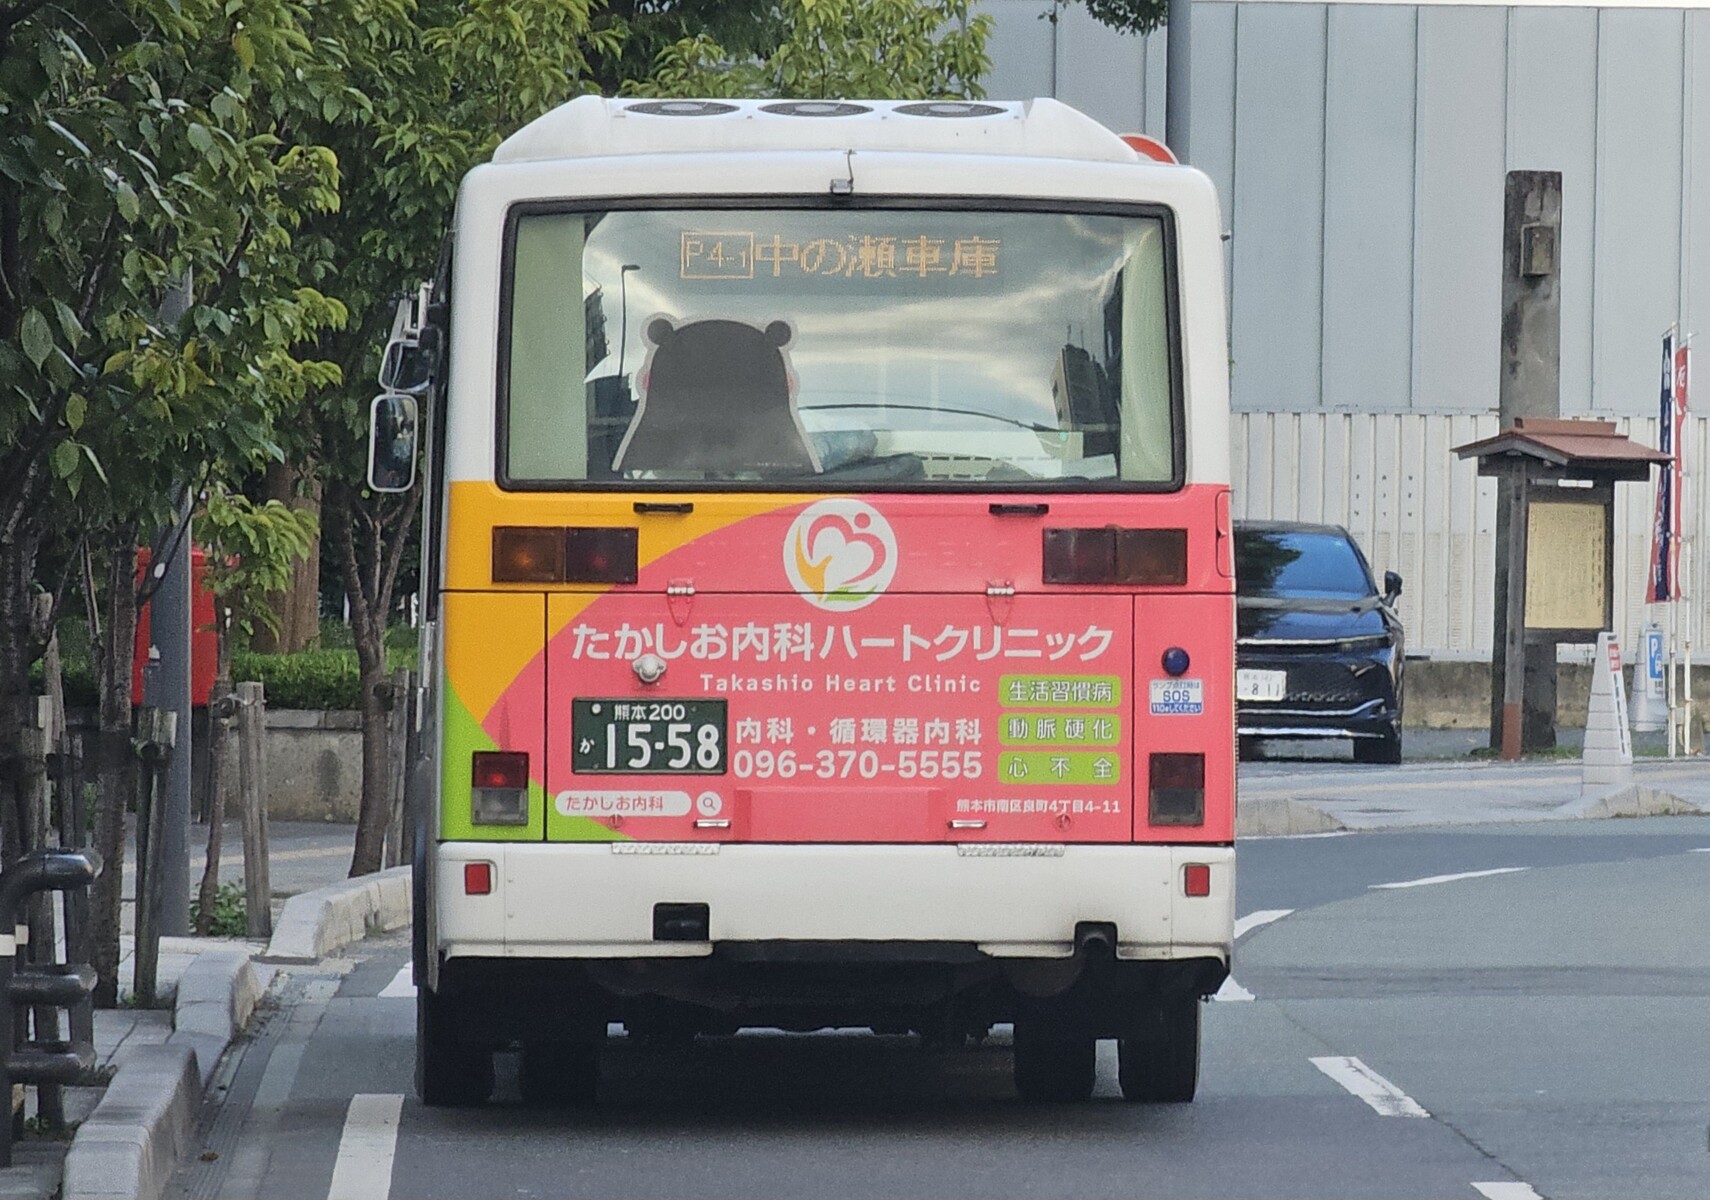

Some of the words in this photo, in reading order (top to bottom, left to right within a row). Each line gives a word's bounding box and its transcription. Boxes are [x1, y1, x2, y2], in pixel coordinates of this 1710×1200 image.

[755, 234, 1001, 278] 中の瀬車庫
[572, 622, 1114, 661] たかしお内科ハートクリニック
[700, 673, 813, 692] Takashio
[826, 673, 896, 692] Heart
[907, 673, 981, 692] Clinic
[1009, 681, 1112, 702] 生活習慣病
[1163, 690, 1190, 702] SOS
[735, 717, 982, 744] 内科・循環器内科
[1009, 719, 1112, 740] 動脈硬化
[579, 737, 595, 754] か
[606, 723, 720, 769] 15-58
[733, 750, 982, 779] 096-370-5555
[1009, 757, 1112, 778] 心不全
[566, 796, 664, 811] たかしお内科
